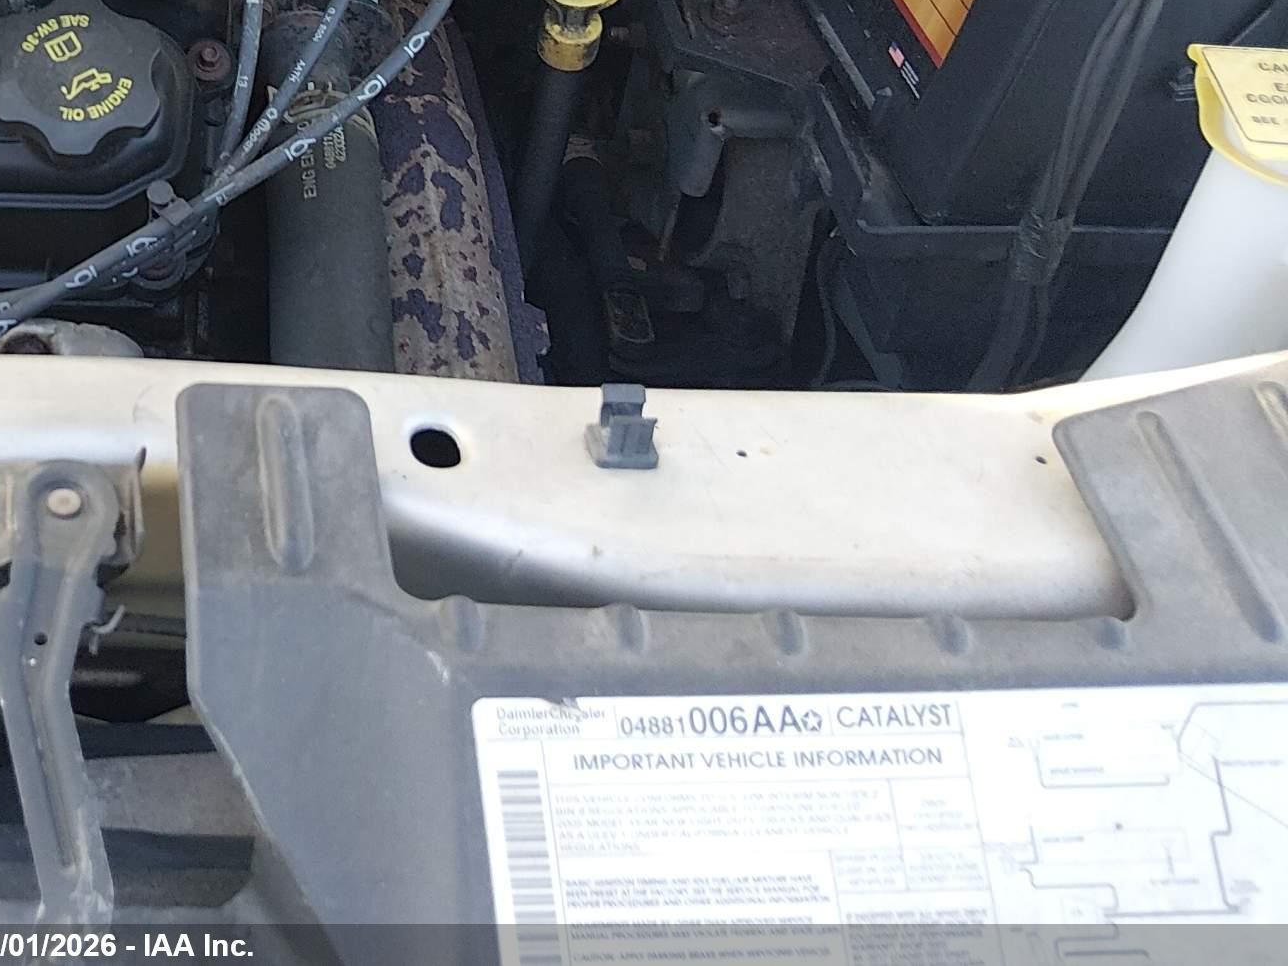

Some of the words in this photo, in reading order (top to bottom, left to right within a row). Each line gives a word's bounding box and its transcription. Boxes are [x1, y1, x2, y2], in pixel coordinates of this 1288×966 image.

[60, 15, 89, 27] SAE
[86, 77, 133, 119] ENGINE
[60, 106, 85, 121] OIL
[837, 703, 951, 728] CATALYST
[499, 723, 581, 739] Corporation
[573, 753, 696, 771] IMPORTANT
[700, 750, 785, 769] VEHICLE
[794, 747, 943, 768] INFORMATION
